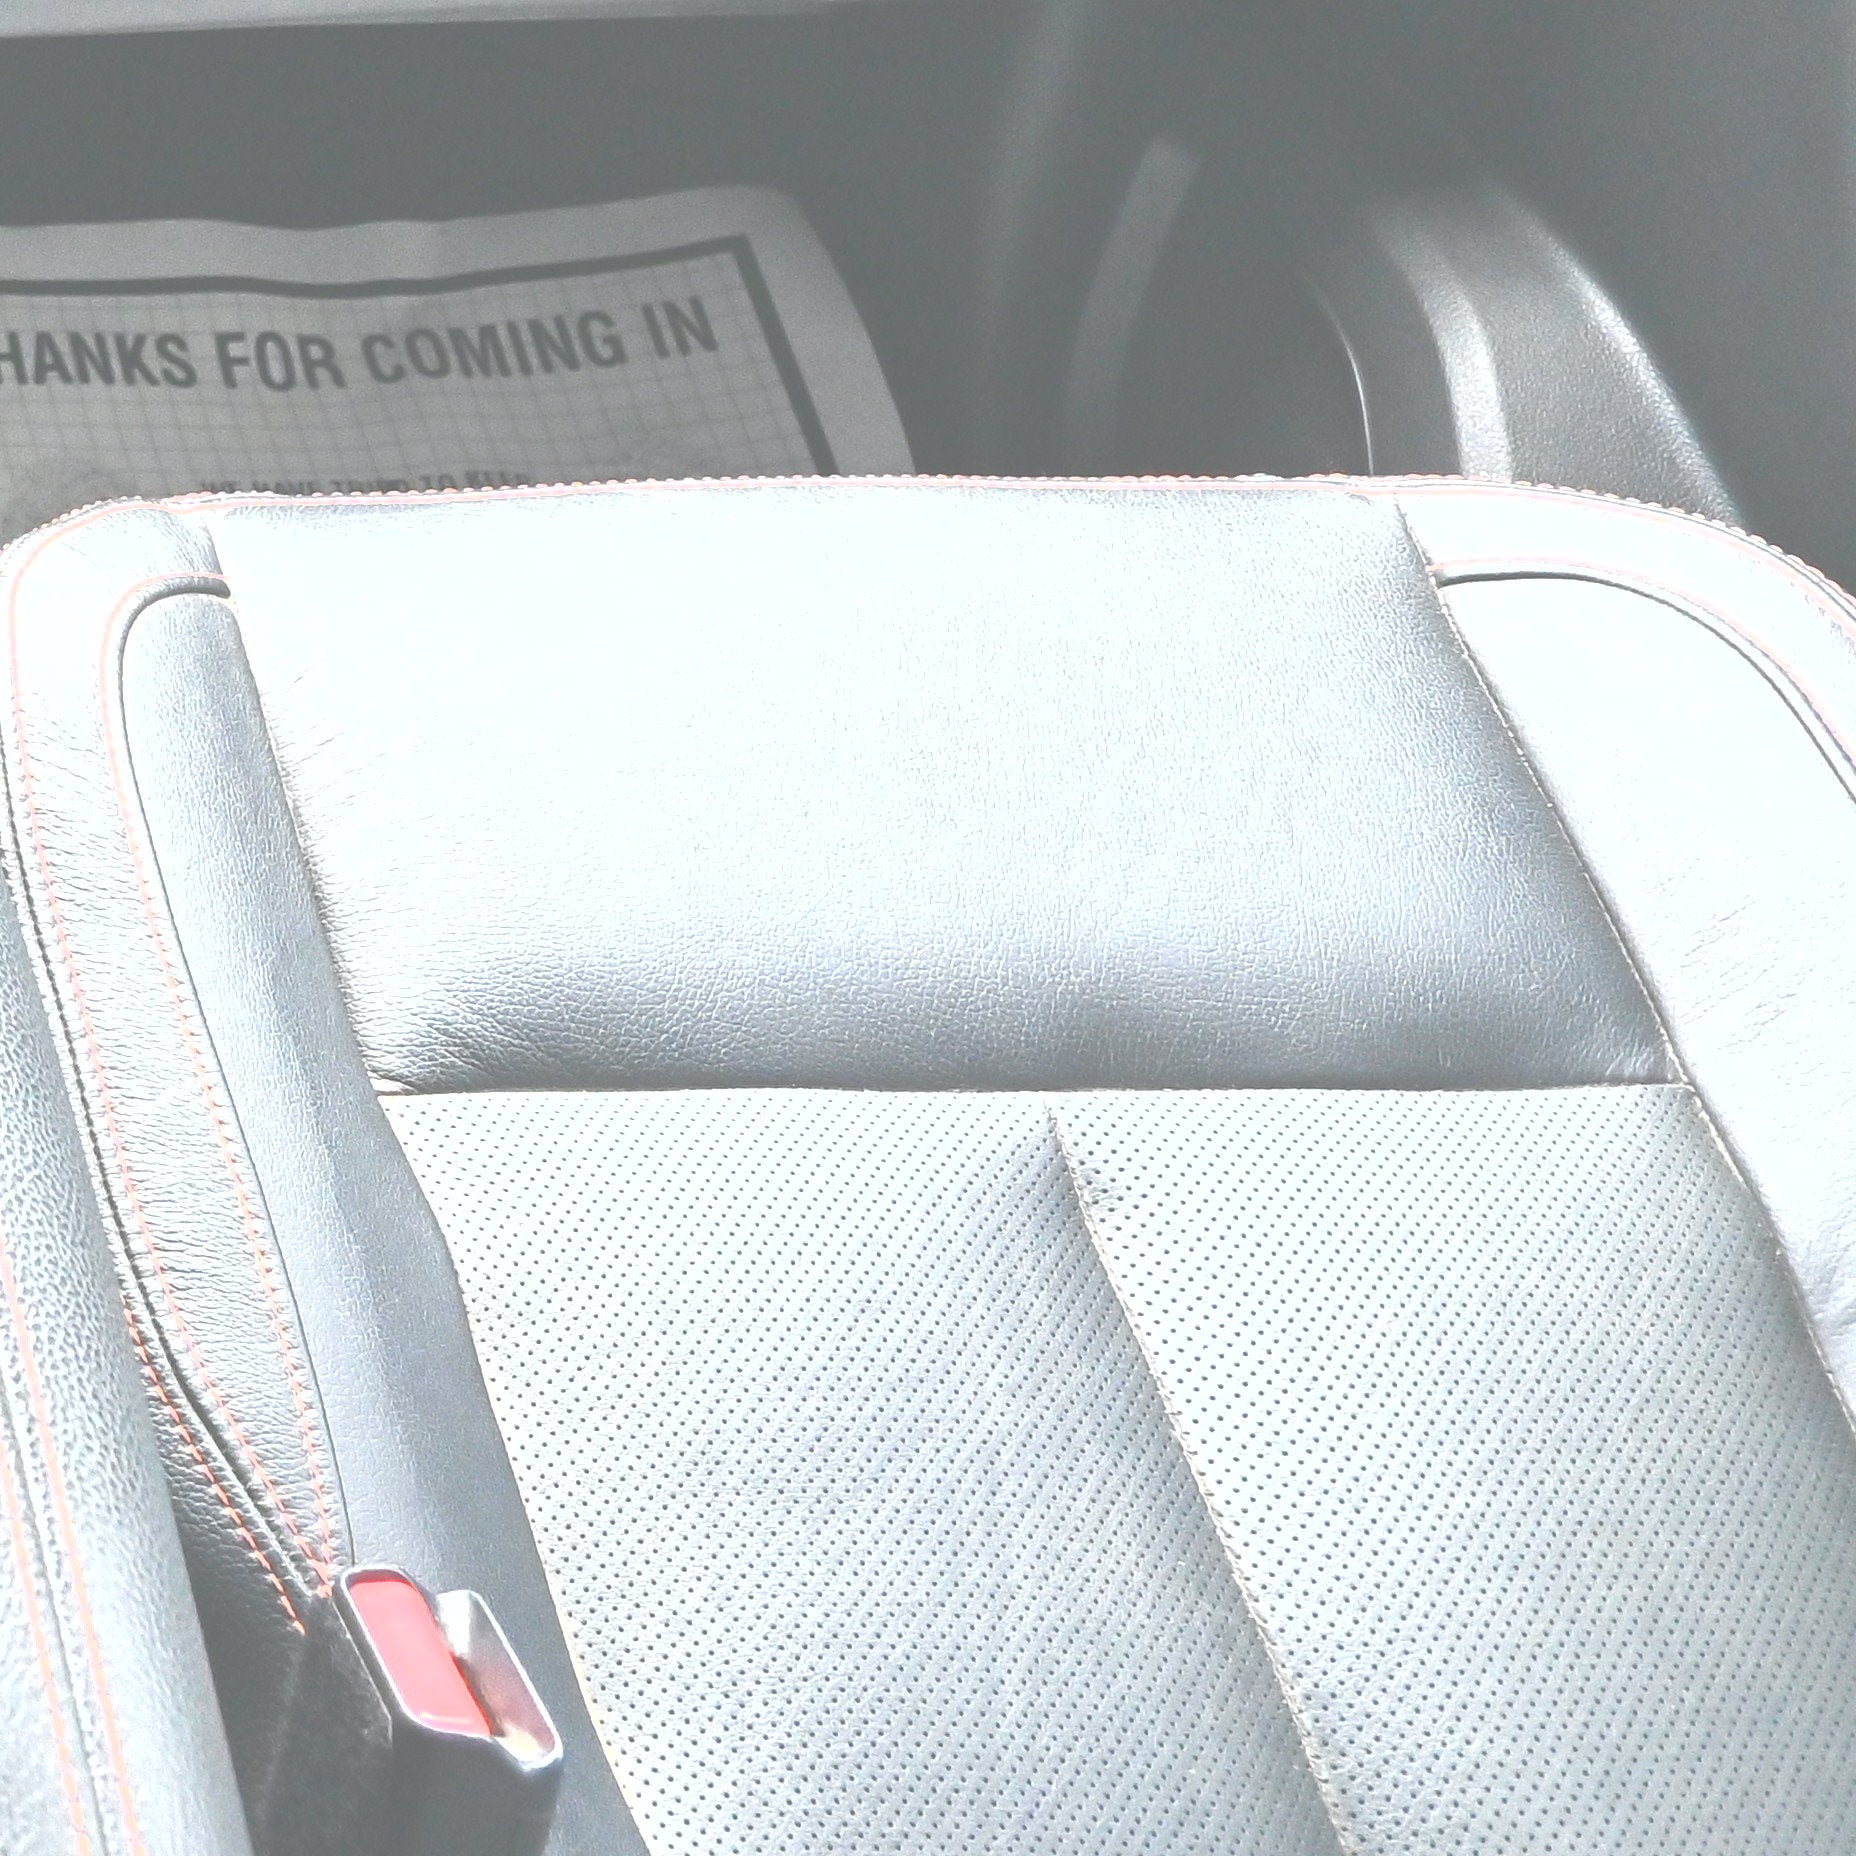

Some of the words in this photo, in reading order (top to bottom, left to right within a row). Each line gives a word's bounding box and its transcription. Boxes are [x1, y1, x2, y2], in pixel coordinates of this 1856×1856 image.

[213, 329, 347, 394] FOR
[362, 310, 627, 385] COMING
[642, 294, 719, 361] IN
